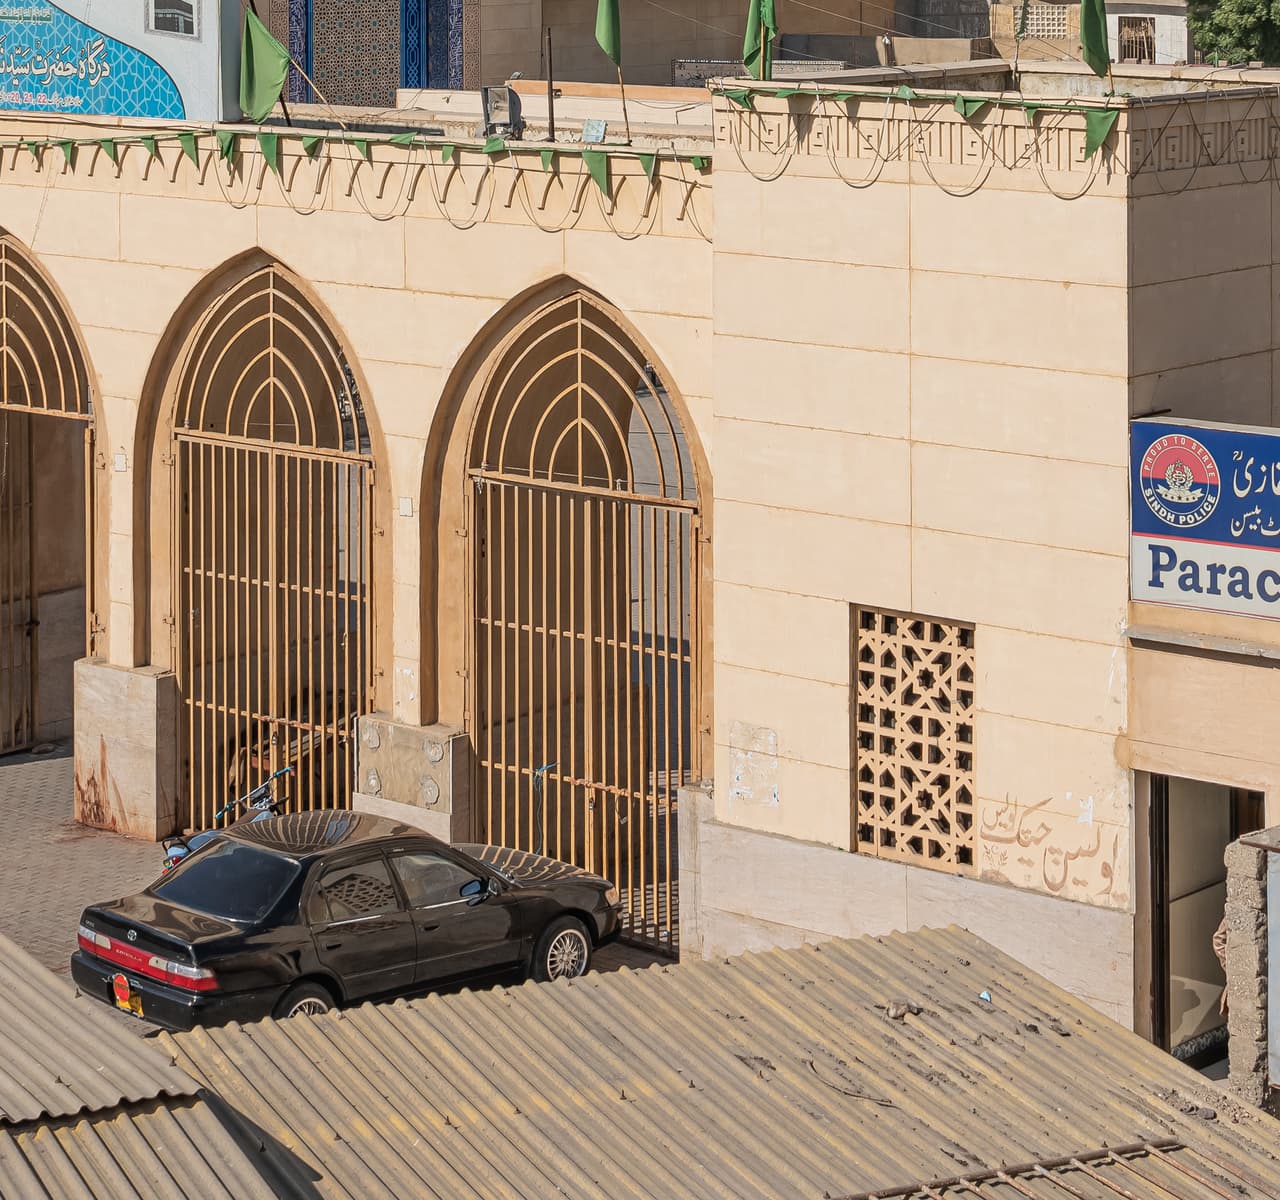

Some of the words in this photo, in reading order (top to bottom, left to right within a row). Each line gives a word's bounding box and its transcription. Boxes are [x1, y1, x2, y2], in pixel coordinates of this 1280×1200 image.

[1144, 439, 1169, 471] PROUD
[1174, 436, 1186, 445] TO
[1191, 443, 1216, 477] SERVE
[1144, 488, 1175, 523] SINDH
[1179, 494, 1216, 525] POLICE
